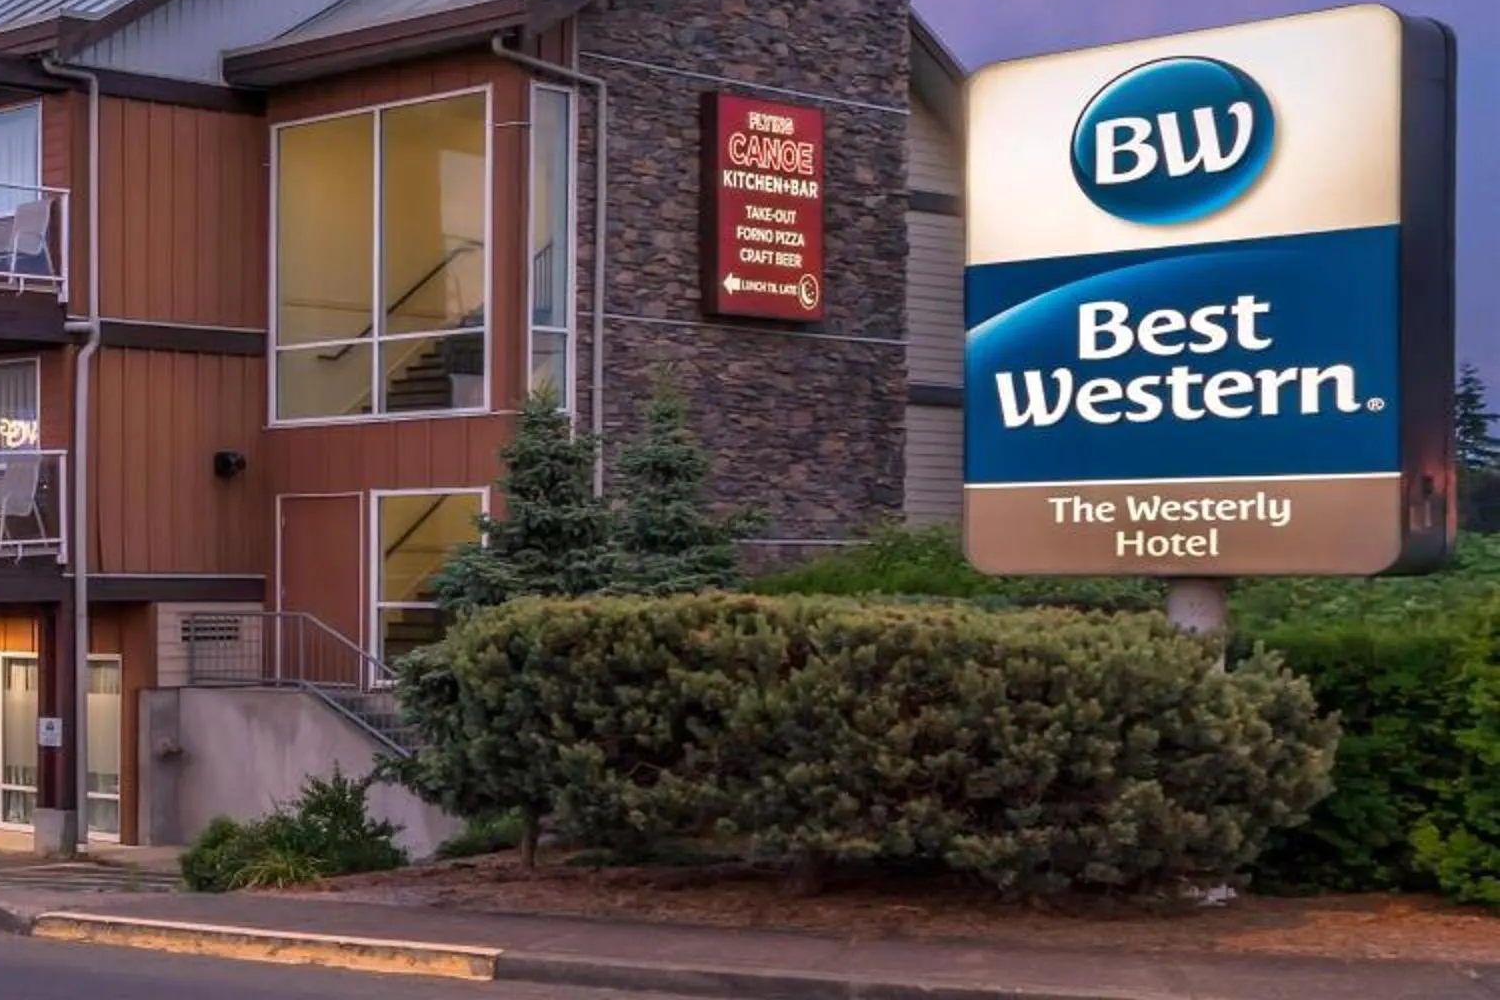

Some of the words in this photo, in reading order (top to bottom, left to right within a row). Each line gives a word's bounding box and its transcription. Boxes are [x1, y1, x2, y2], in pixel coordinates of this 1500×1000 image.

[729, 131, 815, 176] CANOE
[1095, 101, 1254, 185] BW
[745, 205, 797, 225] TAKE-OUT
[775, 230, 805, 248] PIZZA
[739, 247, 774, 265] CRAFT
[775, 251, 803, 269] BEER
[1078, 294, 1273, 361] Best
[1048, 496, 1117, 524] The
[1126, 491, 1293, 527] Westerly
[1115, 528, 1219, 558] Hotel
